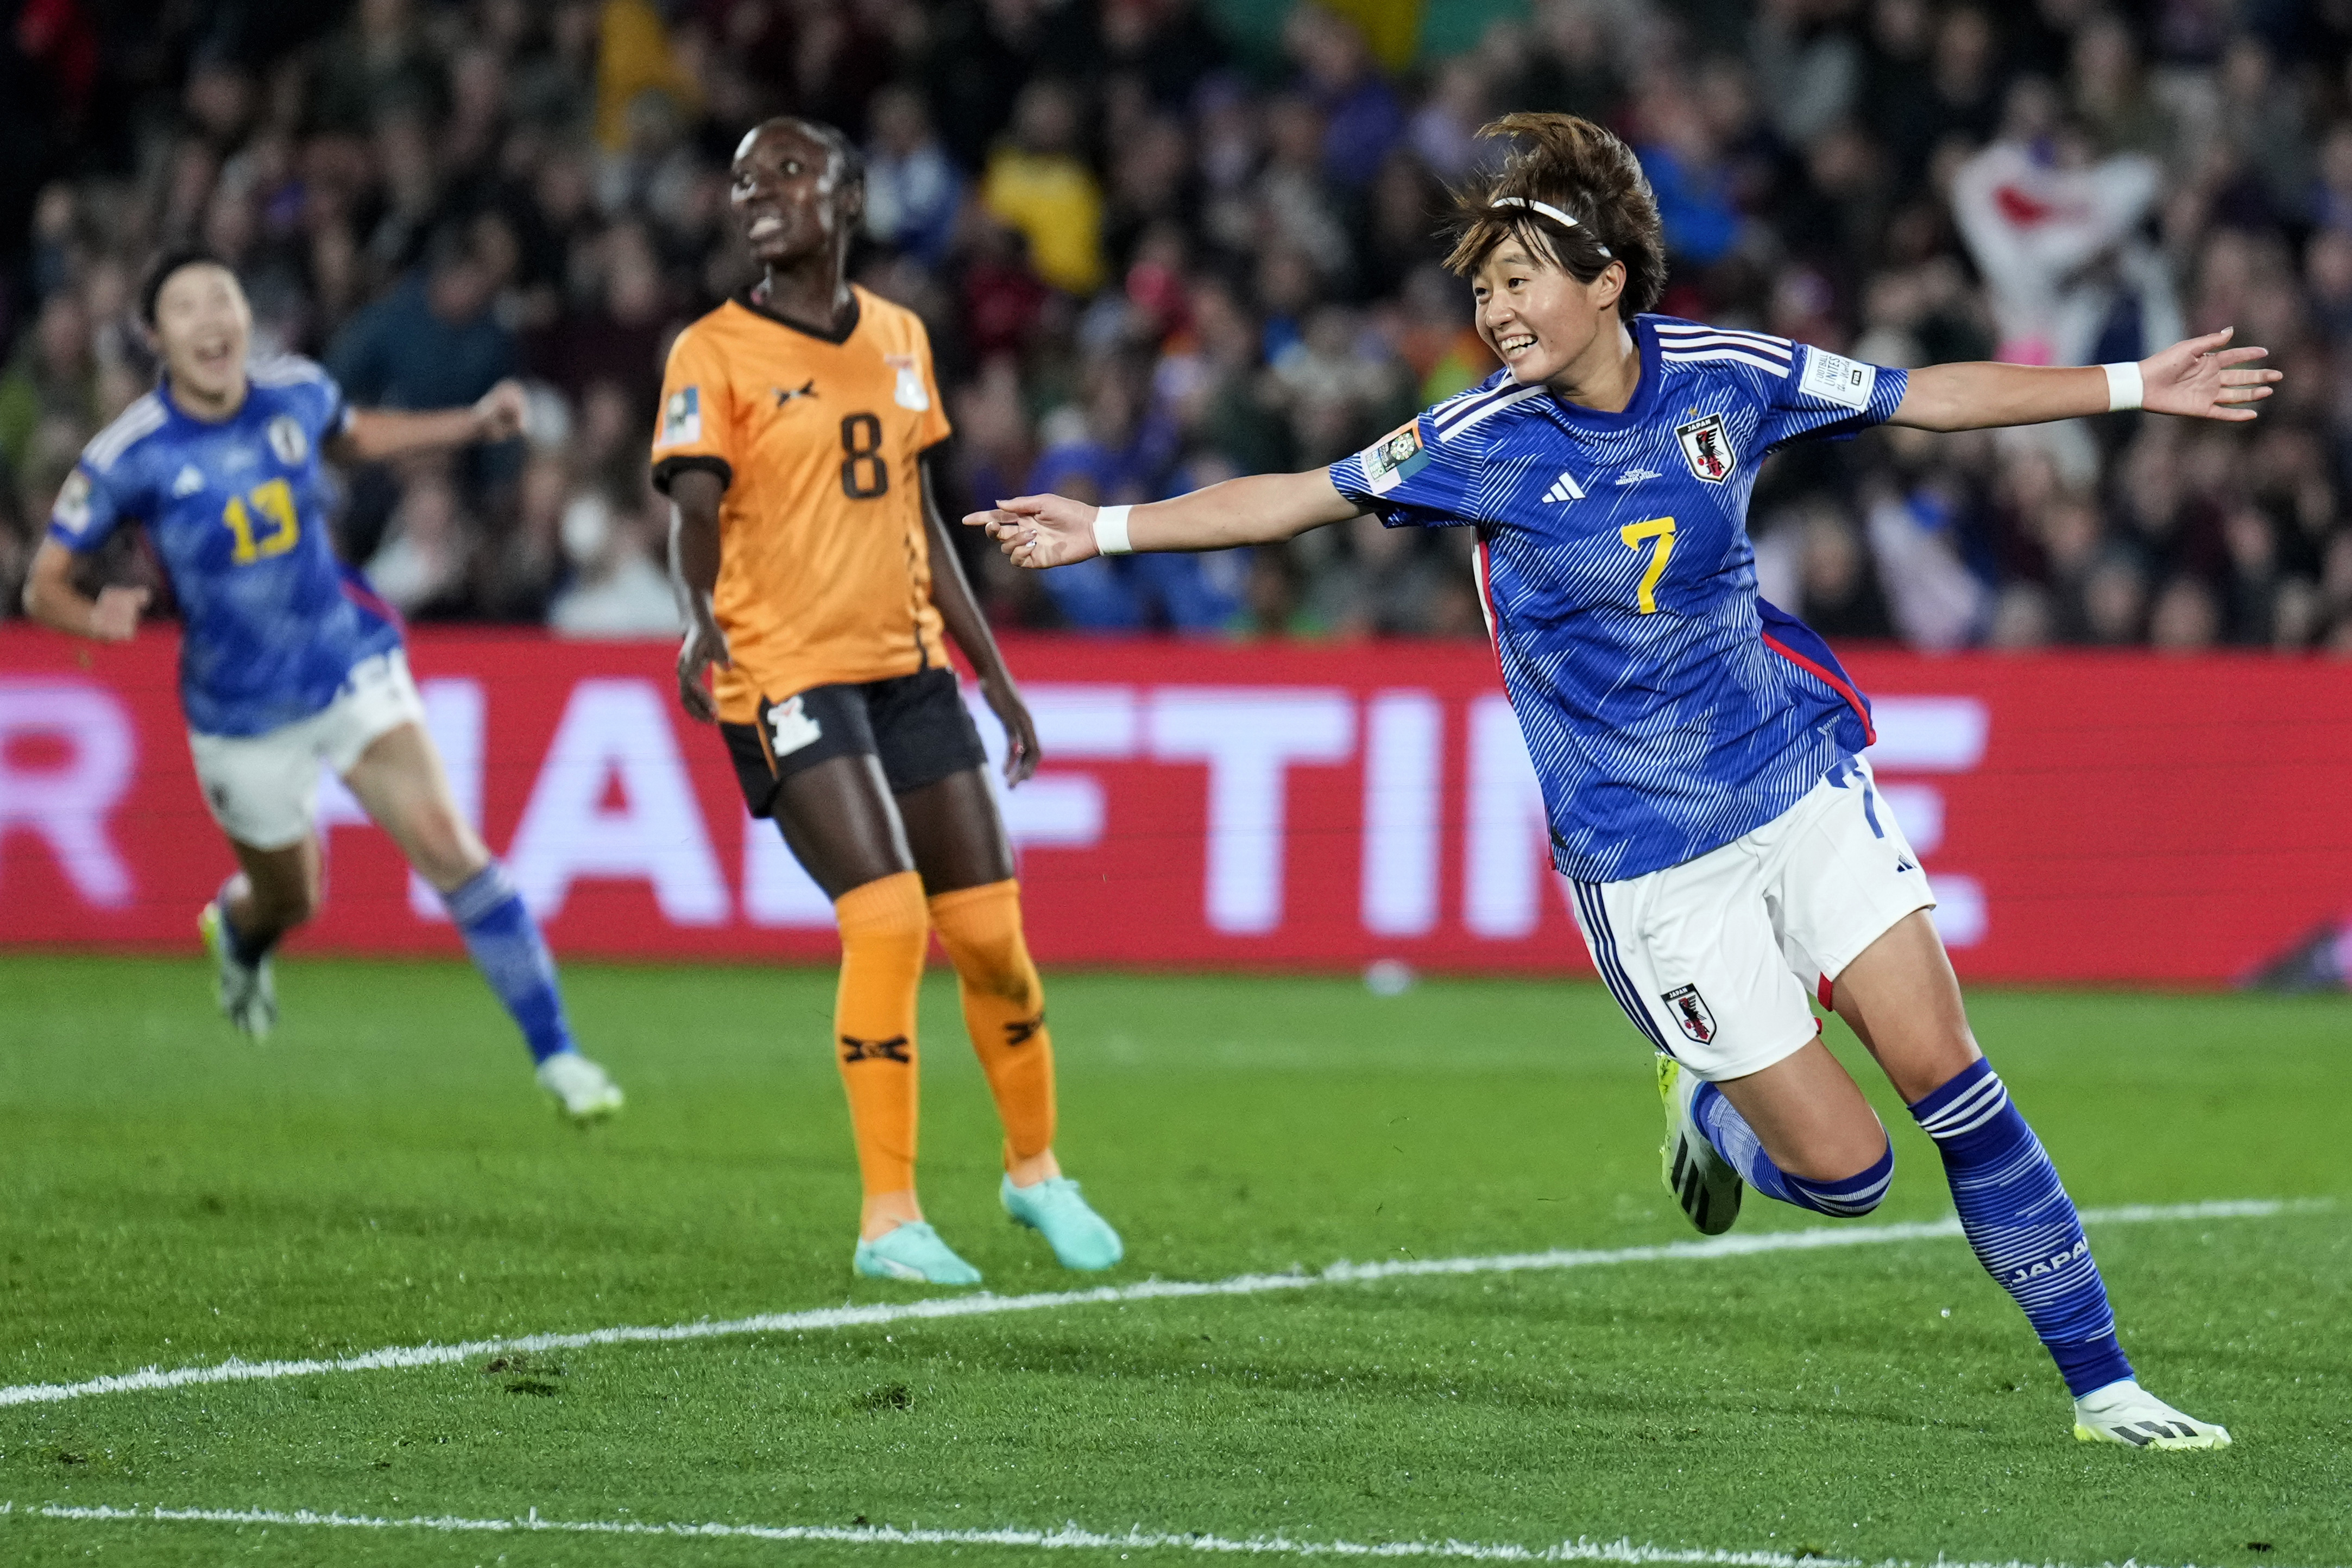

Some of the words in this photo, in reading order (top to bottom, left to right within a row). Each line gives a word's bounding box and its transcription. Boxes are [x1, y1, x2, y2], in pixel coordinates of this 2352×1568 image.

[1814, 354, 1828, 383] FOOTBALL
[1824, 356, 1840, 387] UNITES
[1687, 419, 1711, 432] JAPAN
[840, 412, 890, 500] 8
[223, 476, 300, 566] 13
[1620, 516, 1676, 615] 7
[1669, 987, 1688, 998] JAPAN
